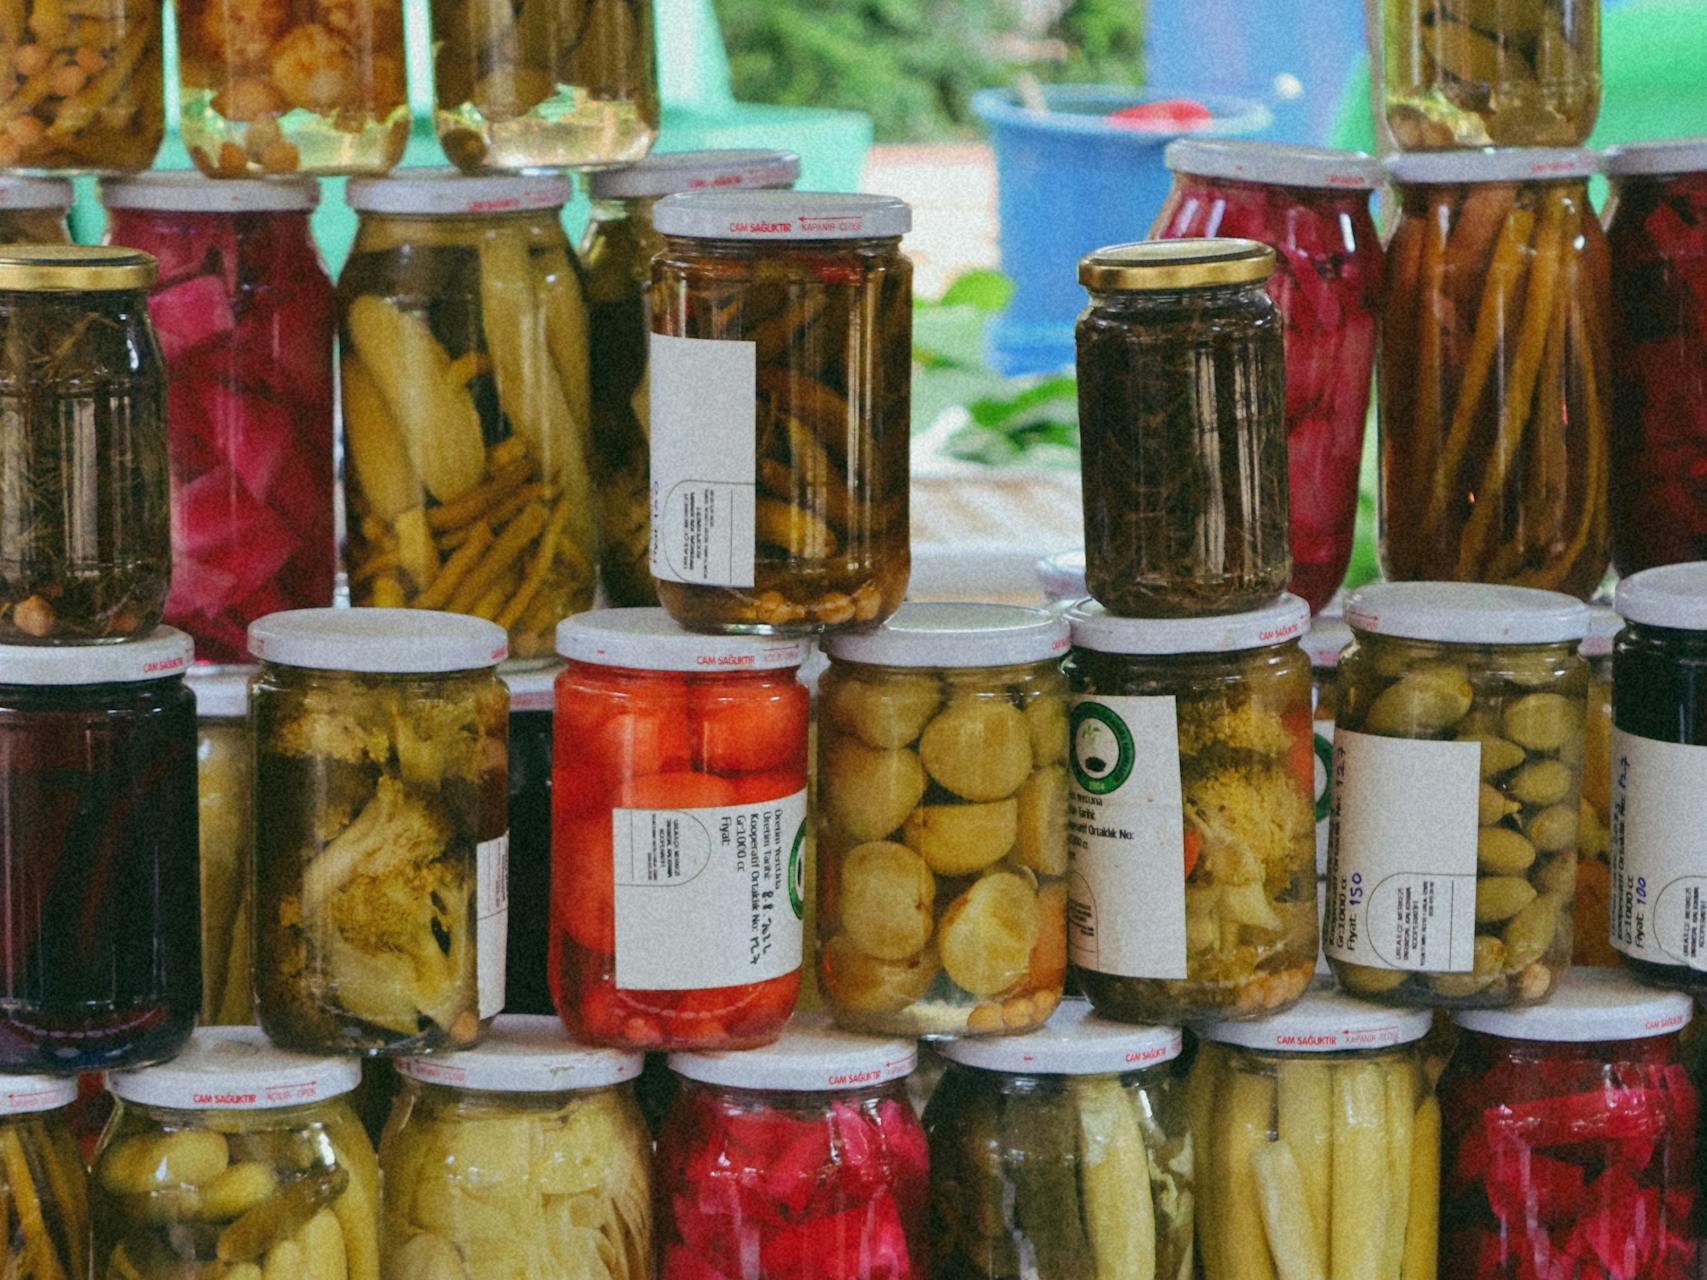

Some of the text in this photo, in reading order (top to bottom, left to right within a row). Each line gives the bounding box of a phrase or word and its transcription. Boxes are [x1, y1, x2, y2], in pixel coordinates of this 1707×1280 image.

[730, 222, 748, 232] CAM
[696, 656, 716, 665] CAM
[720, 817, 732, 847] Fiyat:
[1088, 824, 1117, 838] Ortaklık
[1119, 829, 1135, 840] No:
[763, 812, 771, 880] Üretim Tarihi:
[737, 861, 744, 872] cc
[749, 813, 760, 931] Kooperatif Ortaklık No:
[1348, 872, 1362, 906] 150
[1635, 876, 1646, 905] 100
[1346, 915, 1358, 951] Fiyat:
[1276, 1035, 1295, 1044] CAM
[1126, 1053, 1141, 1062] CAM
[828, 1076, 847, 1085] CAM
[192, 1094, 212, 1104] CAM
